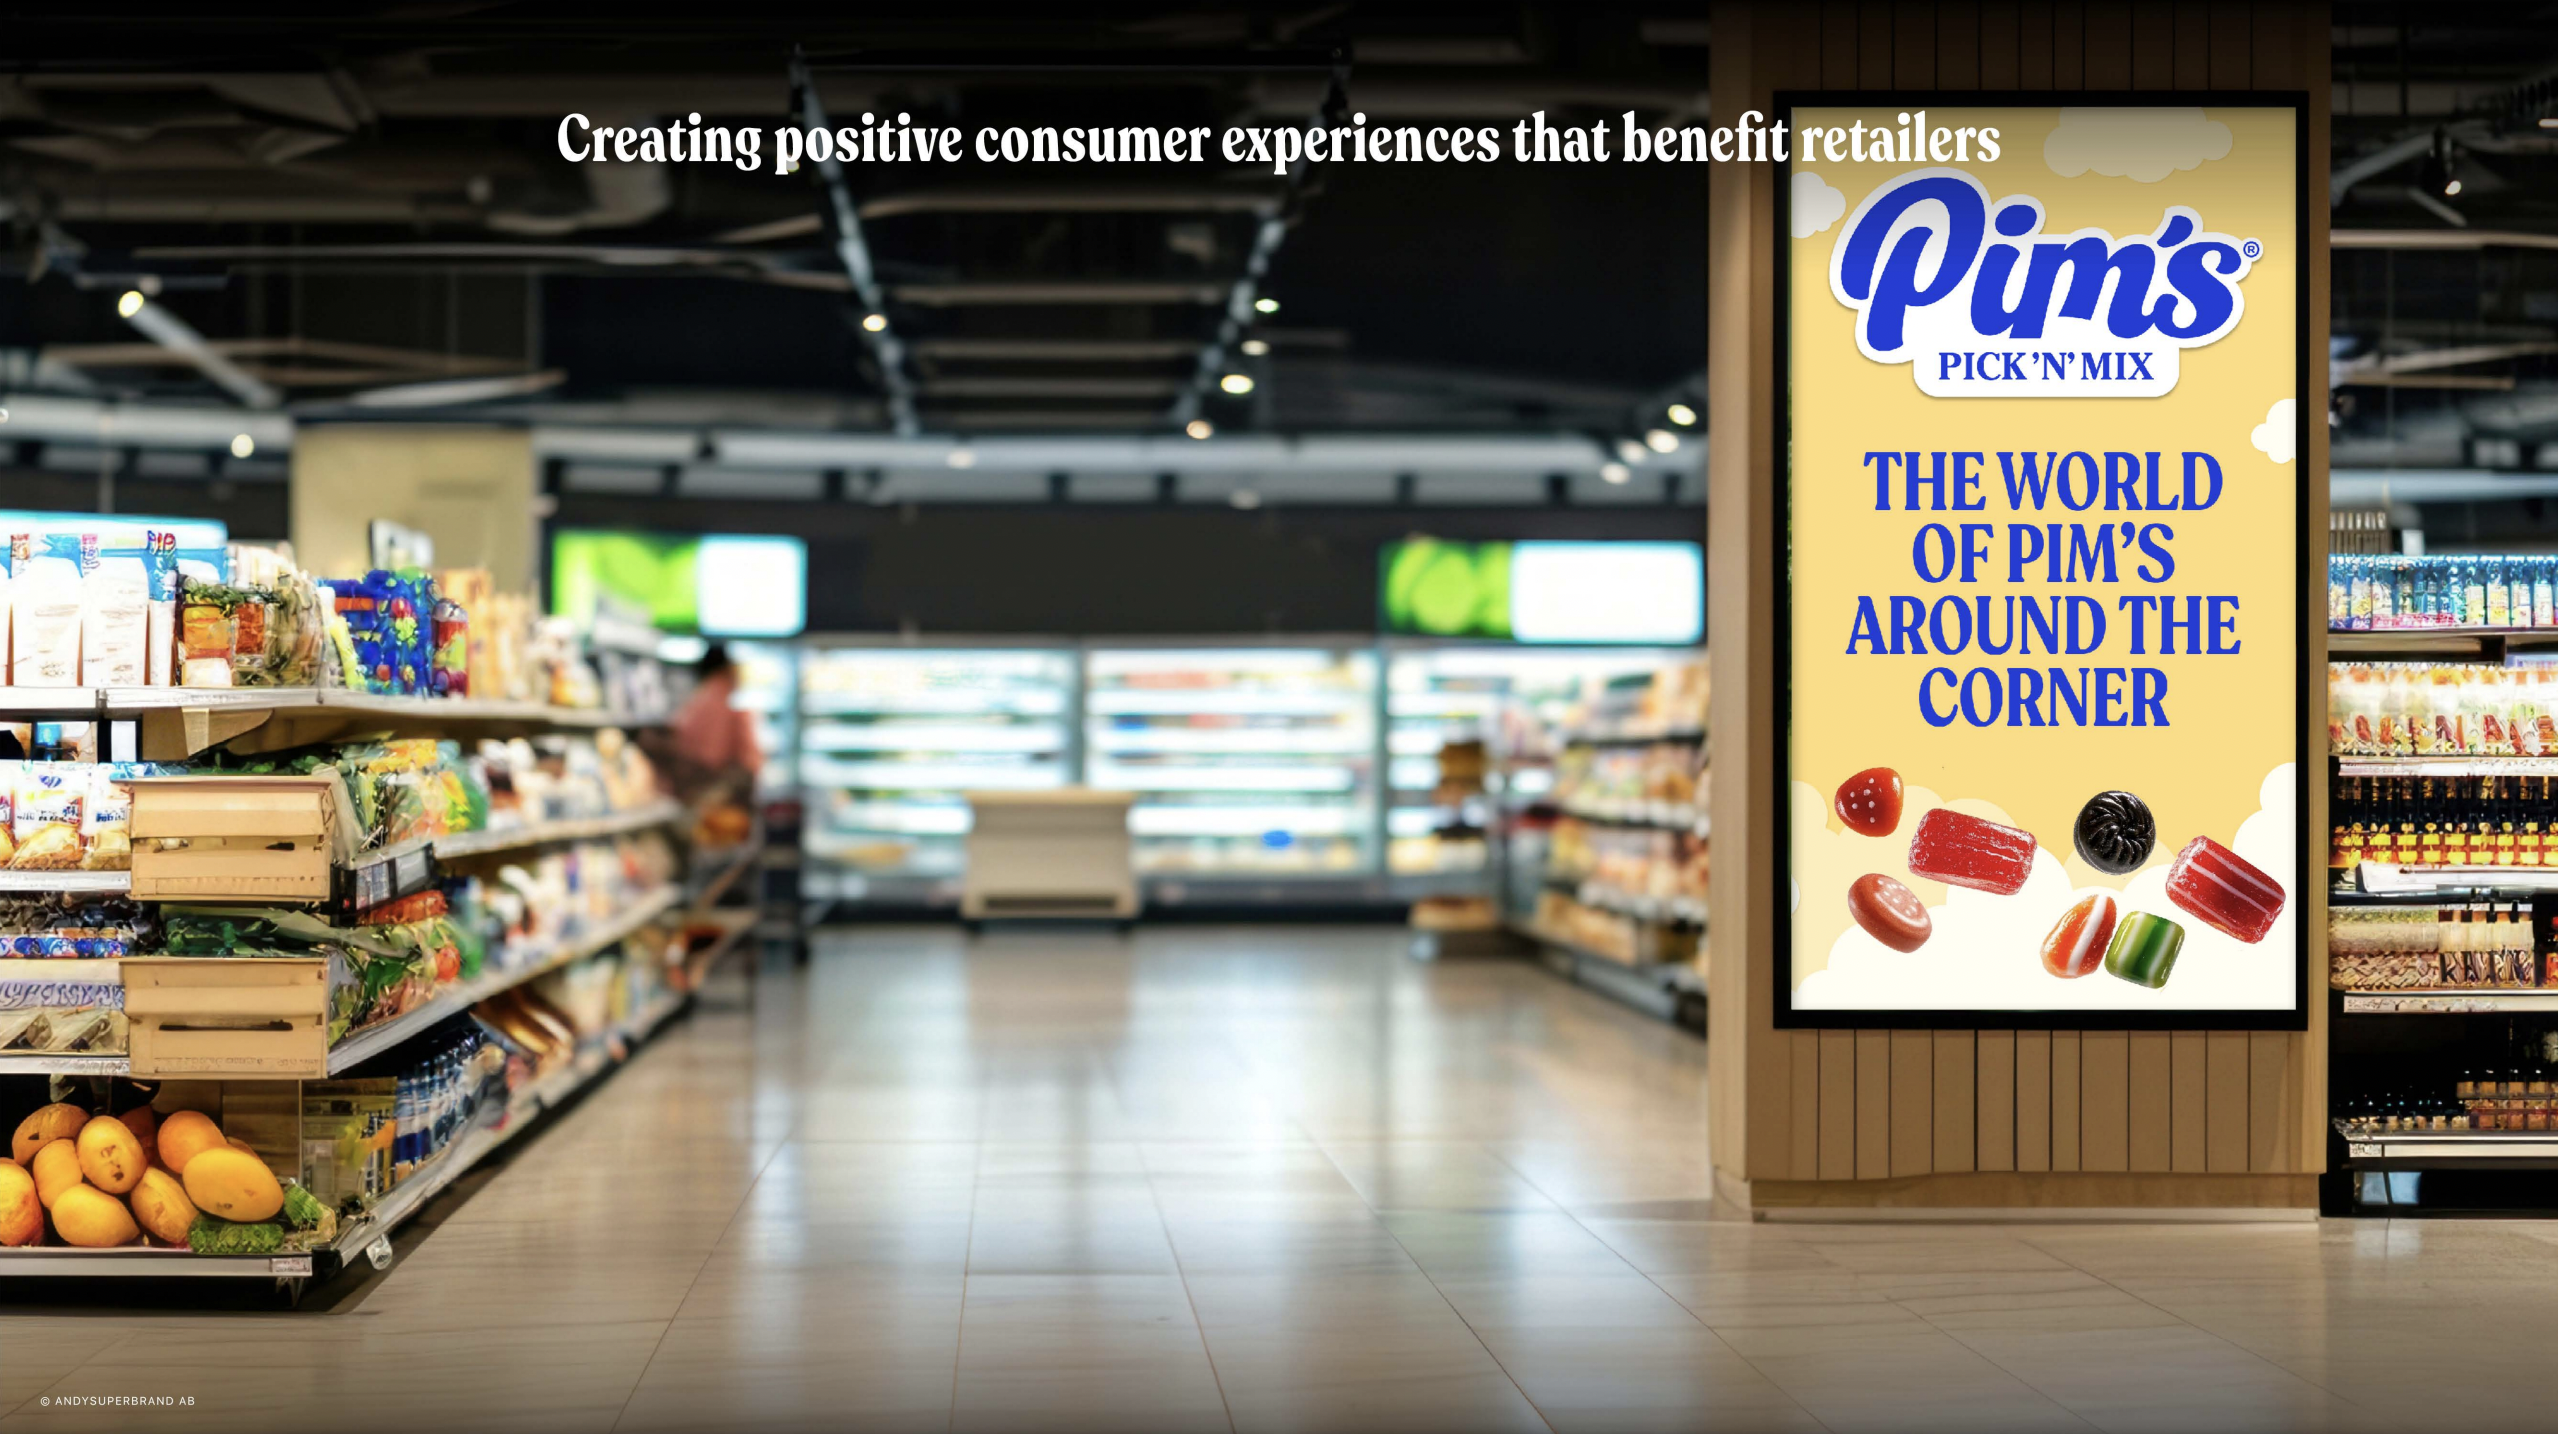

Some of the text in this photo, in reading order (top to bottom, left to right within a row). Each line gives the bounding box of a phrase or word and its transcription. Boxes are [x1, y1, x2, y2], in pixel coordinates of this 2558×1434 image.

[1840, 177, 2242, 352] Pim's
[1939, 351, 2027, 381] PICK
[2081, 352, 2154, 380] MIX
[1863, 451, 2224, 511] THE WORLD
[1912, 521, 2176, 583] OF PIM'S
[1845, 595, 2242, 655] AROUND THE
[1918, 667, 2171, 727] CORNER
